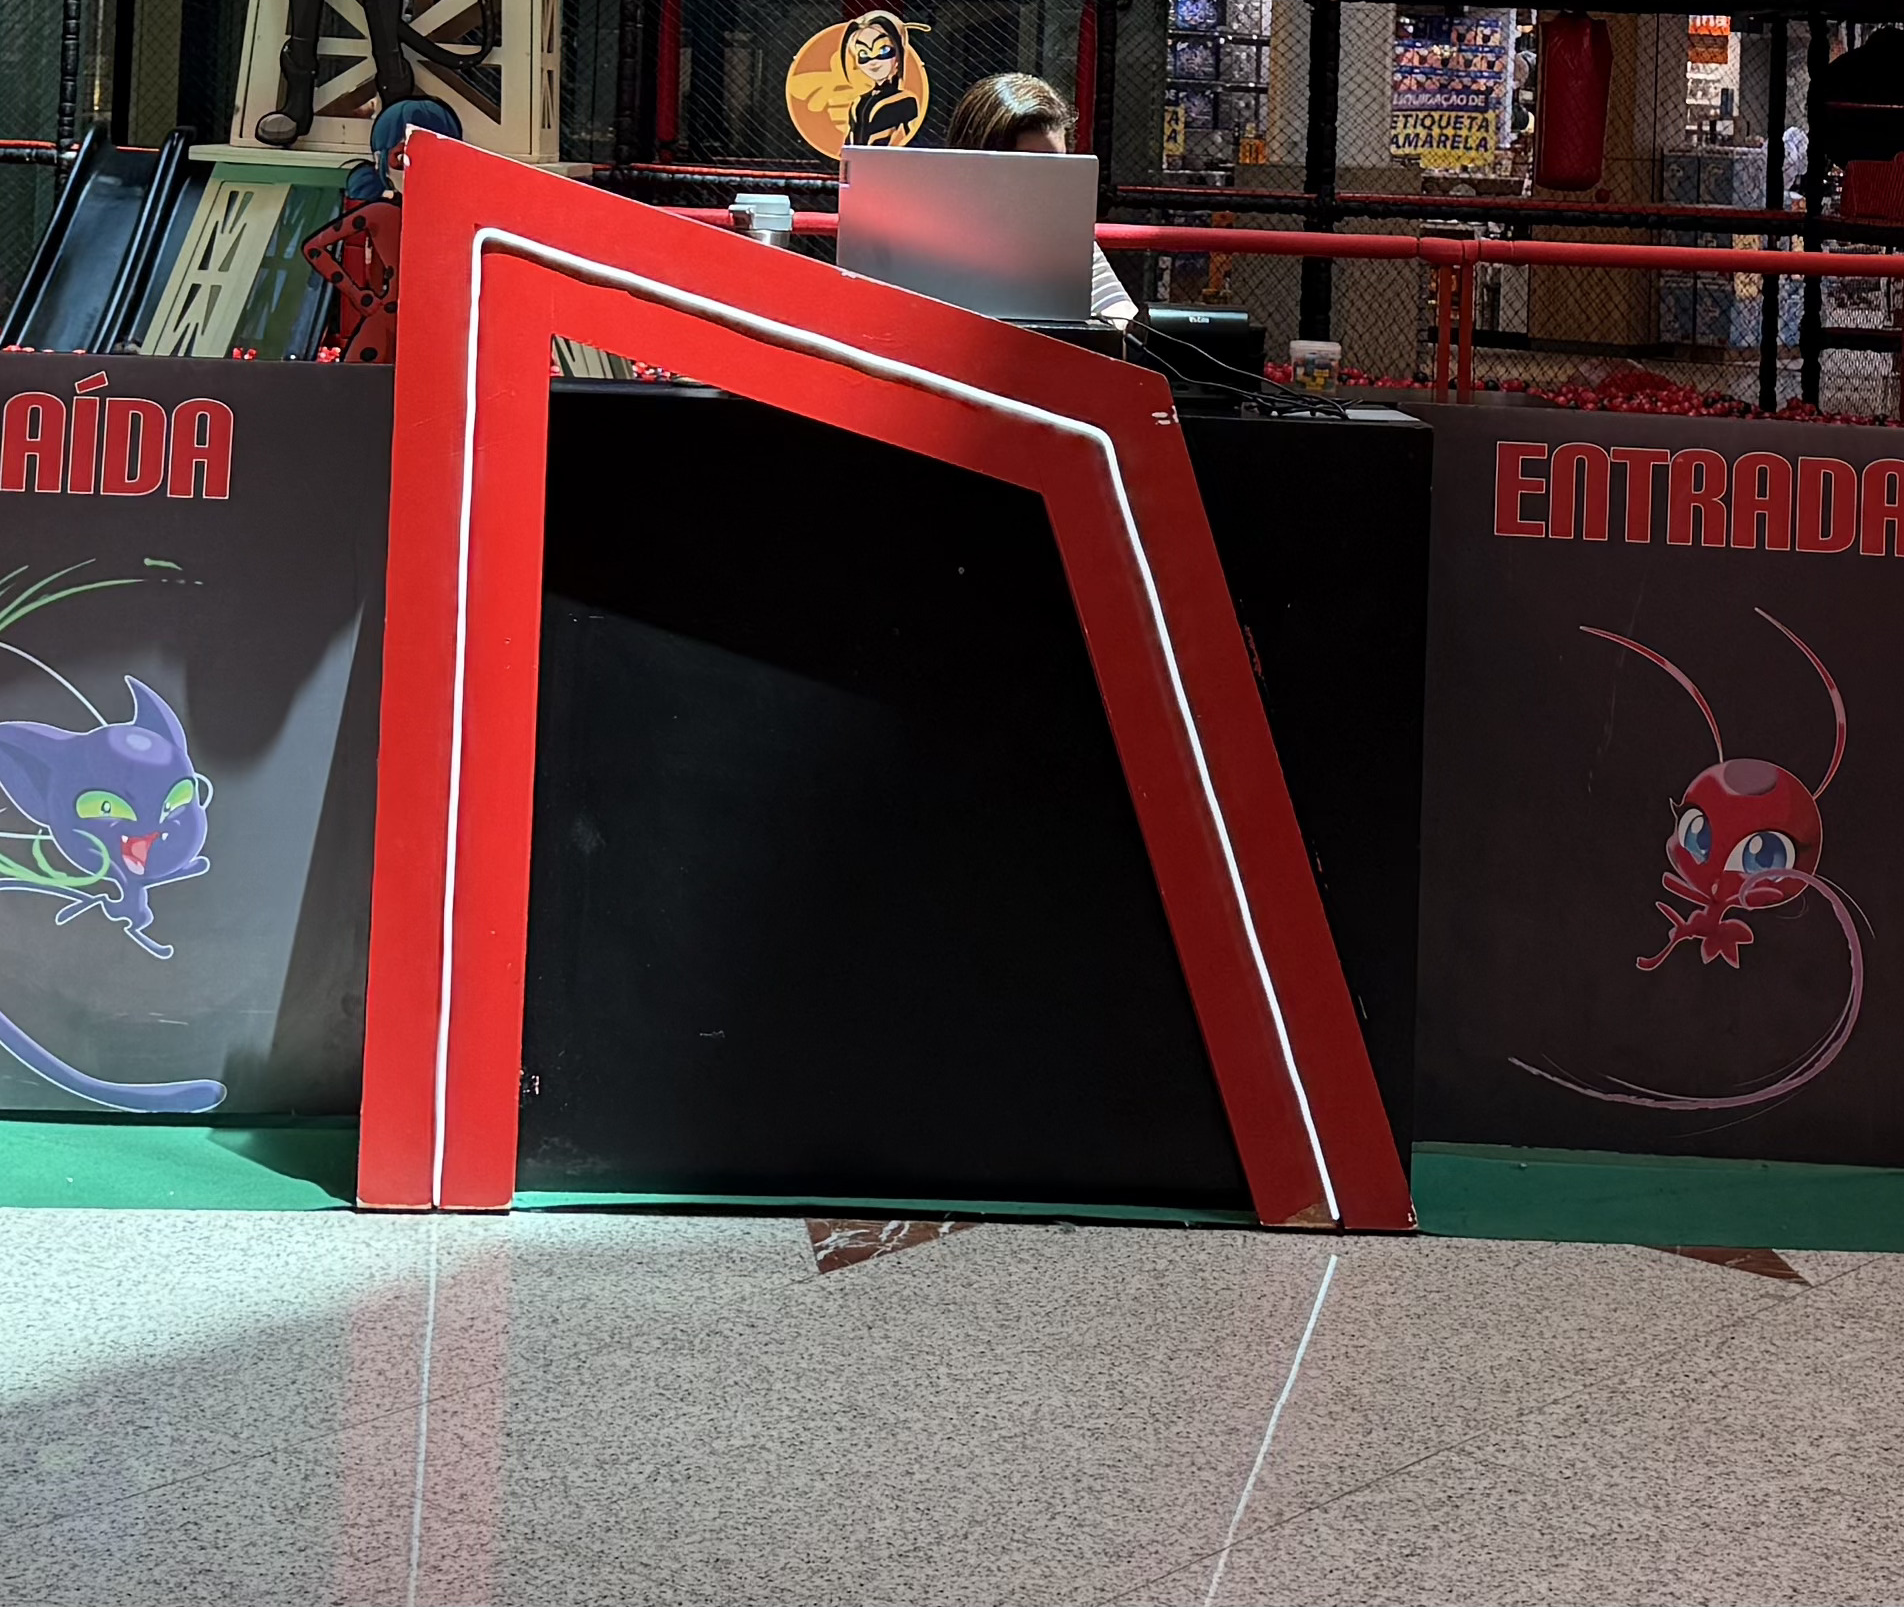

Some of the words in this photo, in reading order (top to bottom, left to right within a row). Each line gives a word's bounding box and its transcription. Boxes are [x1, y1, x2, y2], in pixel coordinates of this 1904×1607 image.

[1468, 95, 1485, 106] DE
[1391, 114, 1489, 133] ETIQUETA
[1391, 133, 1488, 152] AMARELA
